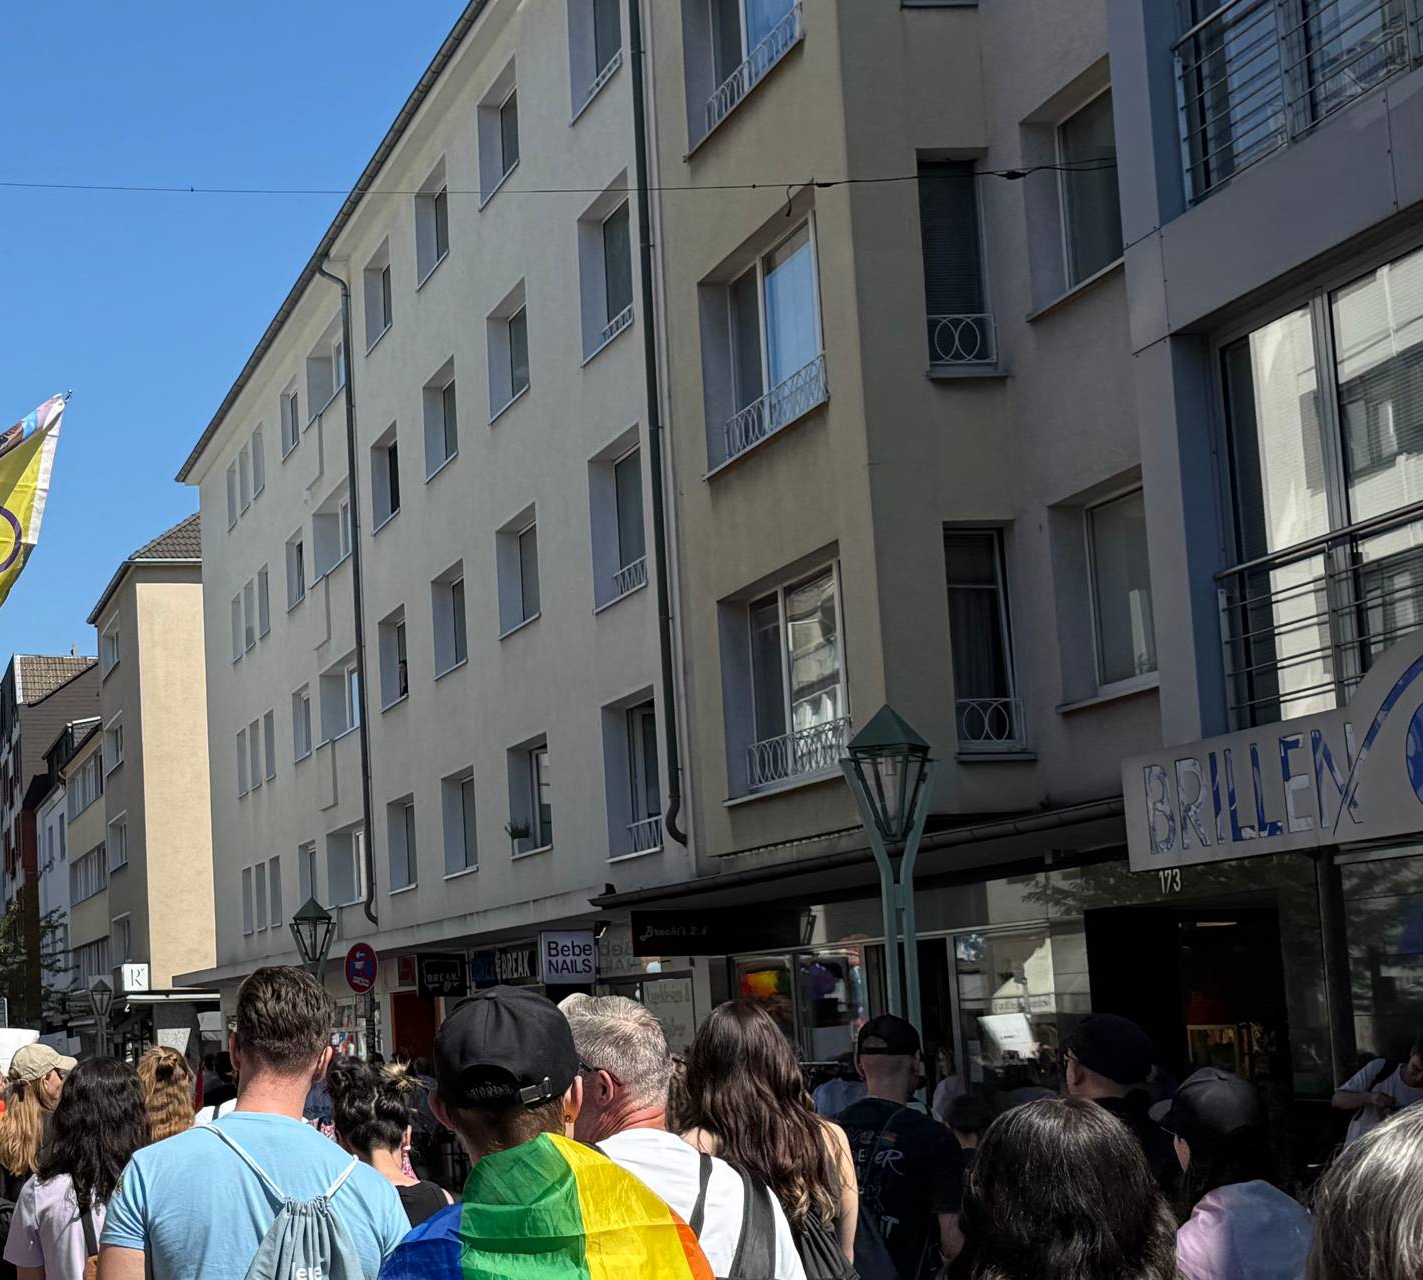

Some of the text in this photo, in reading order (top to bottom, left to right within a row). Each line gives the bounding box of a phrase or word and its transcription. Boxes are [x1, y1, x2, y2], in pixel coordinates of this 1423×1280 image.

[1143, 721, 1364, 856] BRILLEN
[1158, 868, 1182, 894] 173
[547, 941, 592, 957] Bebe
[501, 951, 531, 979] BREAK
[548, 959, 592, 974] NAILS
